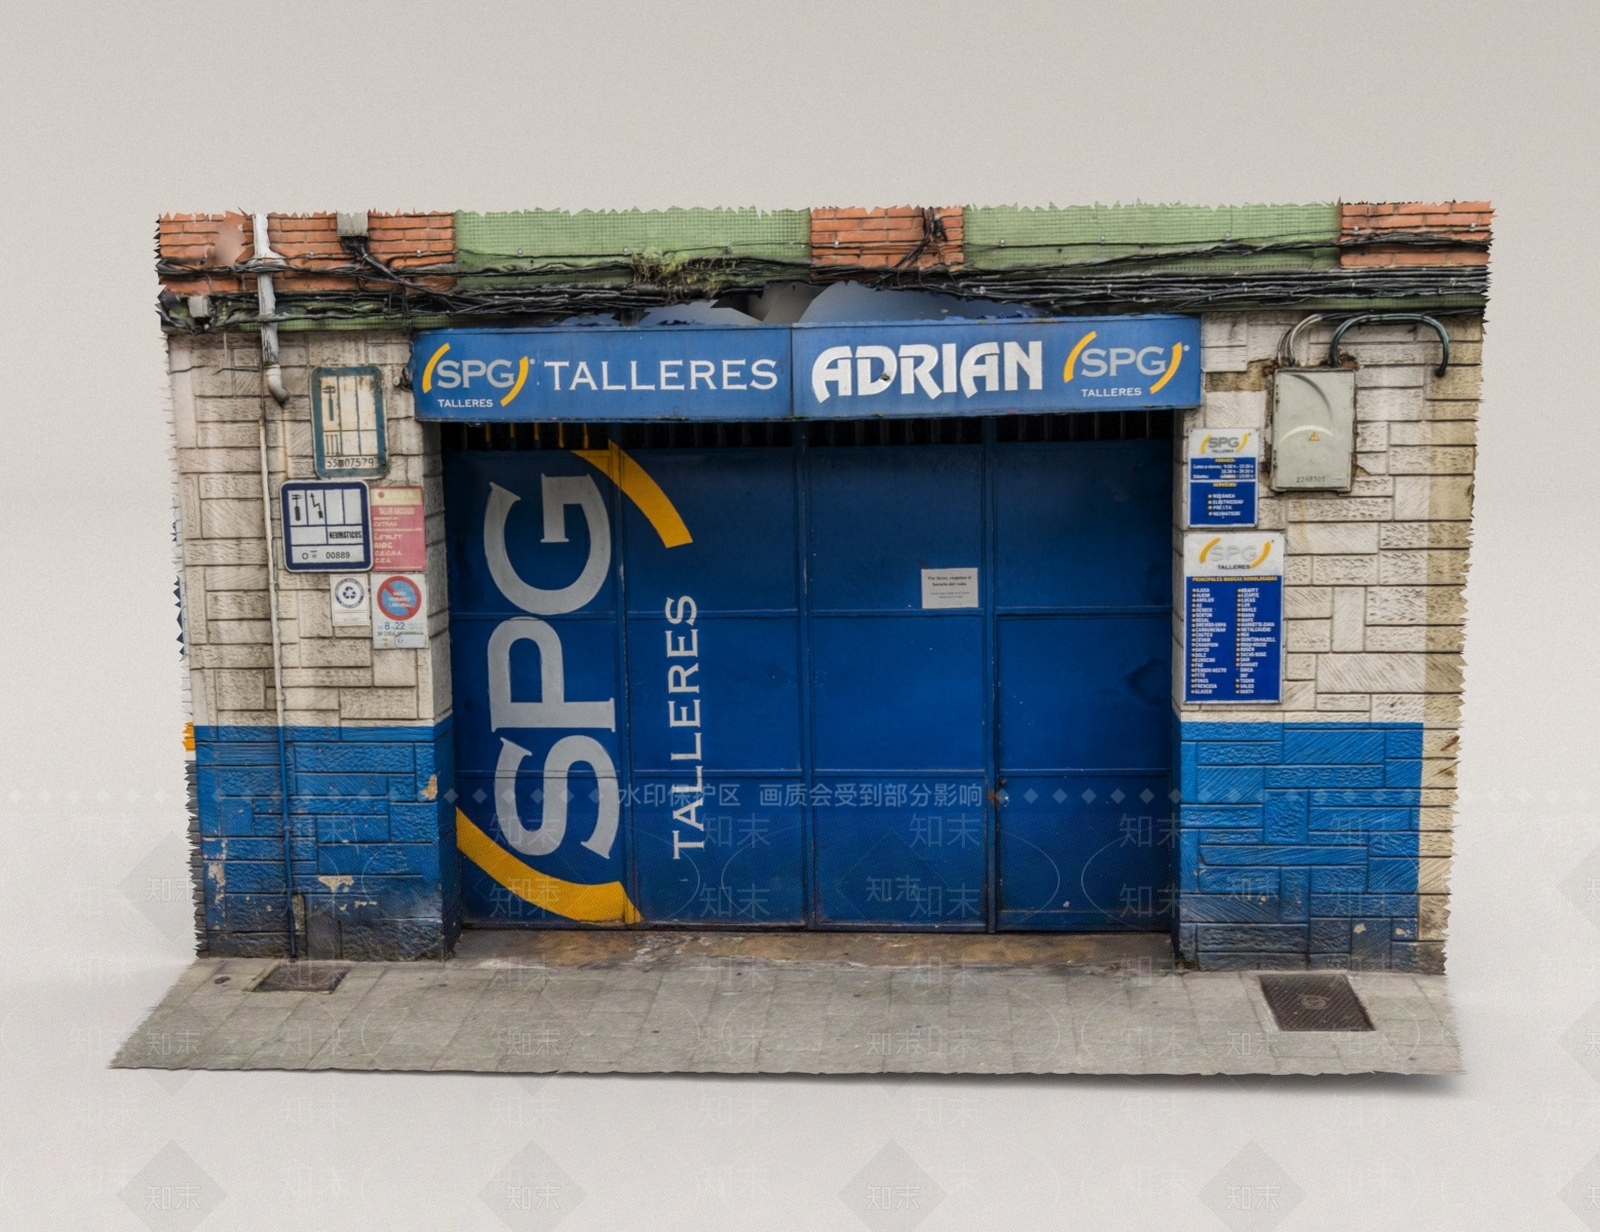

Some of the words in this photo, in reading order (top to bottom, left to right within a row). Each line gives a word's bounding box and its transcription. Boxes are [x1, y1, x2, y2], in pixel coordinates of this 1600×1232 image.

[544, 358, 779, 391] TALLERES
[811, 341, 1043, 404] ADRIAN
[1080, 387, 1142, 398] TALLERES
[437, 399, 493, 408] TALLERES
[328, 531, 362, 539] NEUMATICOS
[325, 551, 351, 560] 00889
[384, 621, 390, 630] 8
[394, 621, 406, 630] 22
[483, 474, 622, 860] SPG
[664, 595, 705, 860] TALLERES
